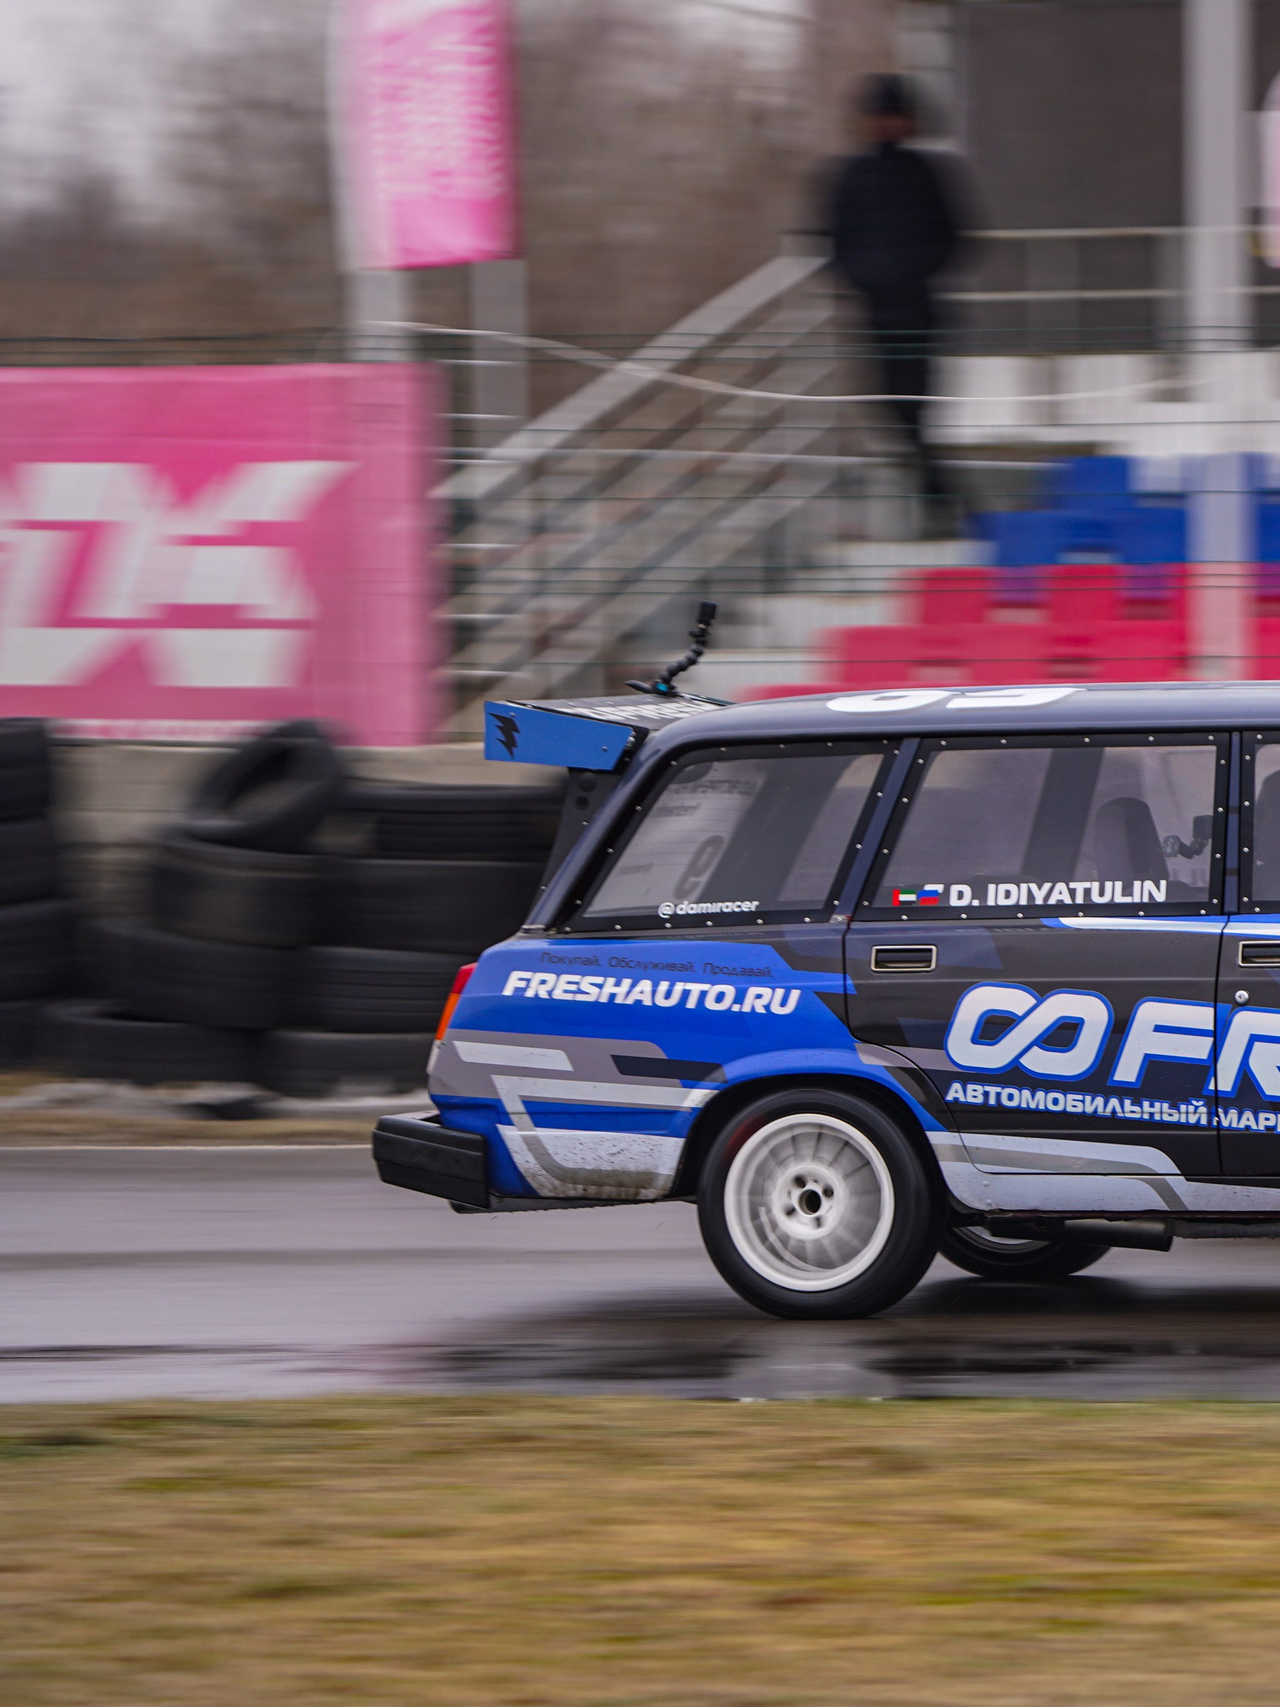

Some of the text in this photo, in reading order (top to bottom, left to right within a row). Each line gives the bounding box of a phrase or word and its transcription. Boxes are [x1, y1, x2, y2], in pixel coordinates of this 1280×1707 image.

[658, 900, 760, 919] @damiracer
[949, 880, 1167, 907] D. IDIYATULIN
[501, 971, 802, 1015] FRESHAUTO.RU
[946, 1079, 1209, 1126] АВТОМОБИЛЬНЫЙ
